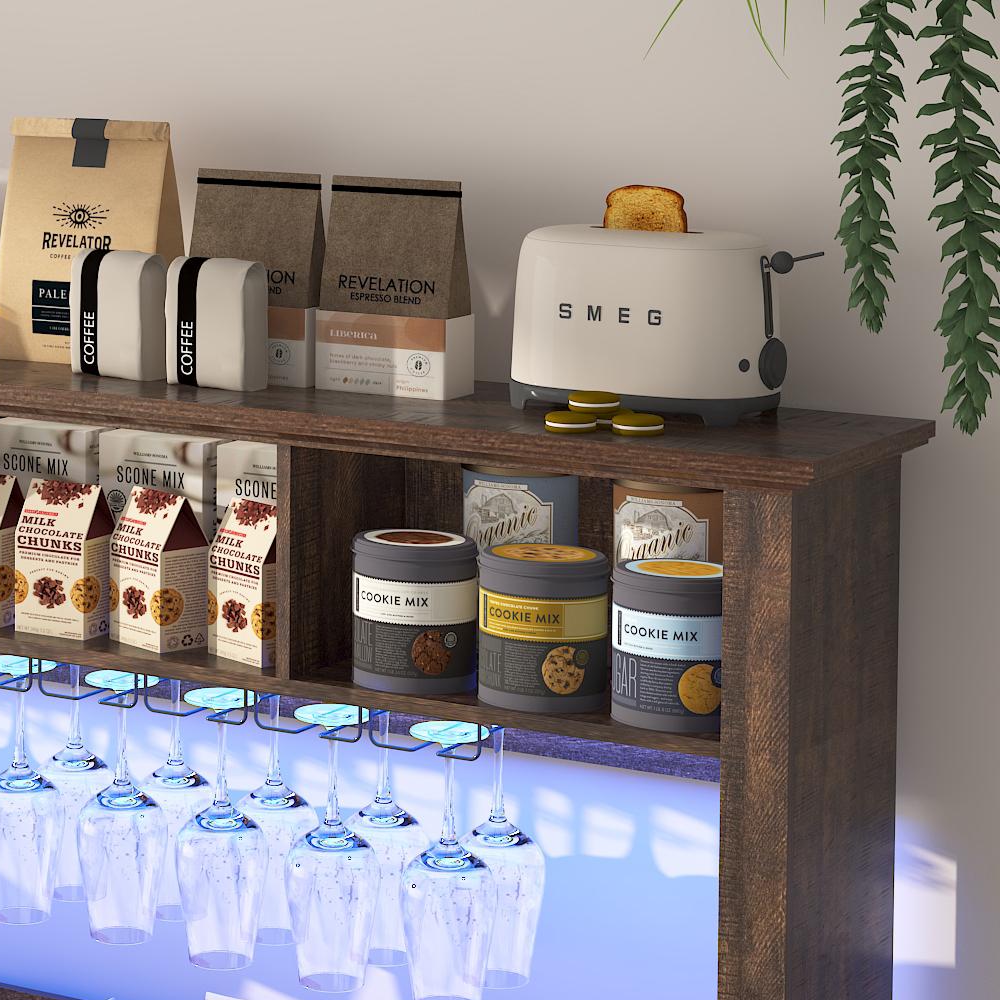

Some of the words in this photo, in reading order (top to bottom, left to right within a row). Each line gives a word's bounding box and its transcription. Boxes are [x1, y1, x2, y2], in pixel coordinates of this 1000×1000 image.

[42, 232, 111, 250] REVELATOR
[39, 288, 68, 299] PALE
[338, 275, 435, 295] REVELATION
[350, 292, 391, 303] ESPRESSO
[393, 294, 421, 305] BLEND
[559, 303, 661, 326] SMEG
[83, 311, 95, 365] COFFEE
[181, 320, 193, 375] COFFEE
[3, 453, 42, 474] SCONE
[47, 458, 68, 476] MIX
[116, 465, 157, 487] SCONE
[162, 471, 185, 490] MIX
[235, 478, 277, 500] SCONE
[21, 516, 56, 527] MILK
[117, 523, 144, 536] MILK
[19, 526, 84, 540] CHOCOLATE
[112, 533, 162, 551] CHOCOLATE
[216, 535, 244, 548] MILK
[17, 535, 82, 551] CHUNKS
[111, 543, 159, 563] CHUNKS
[211, 545, 263, 564] CHOCOLATE
[210, 555, 260, 576] CHUNKS
[361, 590, 401, 606] COOKIE
[405, 597, 429, 607] MIX
[489, 606, 532, 623] COOKIE
[535, 614, 561, 624] MIX
[624, 623, 669, 640] COOKIE
[673, 631, 698, 642] MIX
[613, 653, 637, 699] GAR
